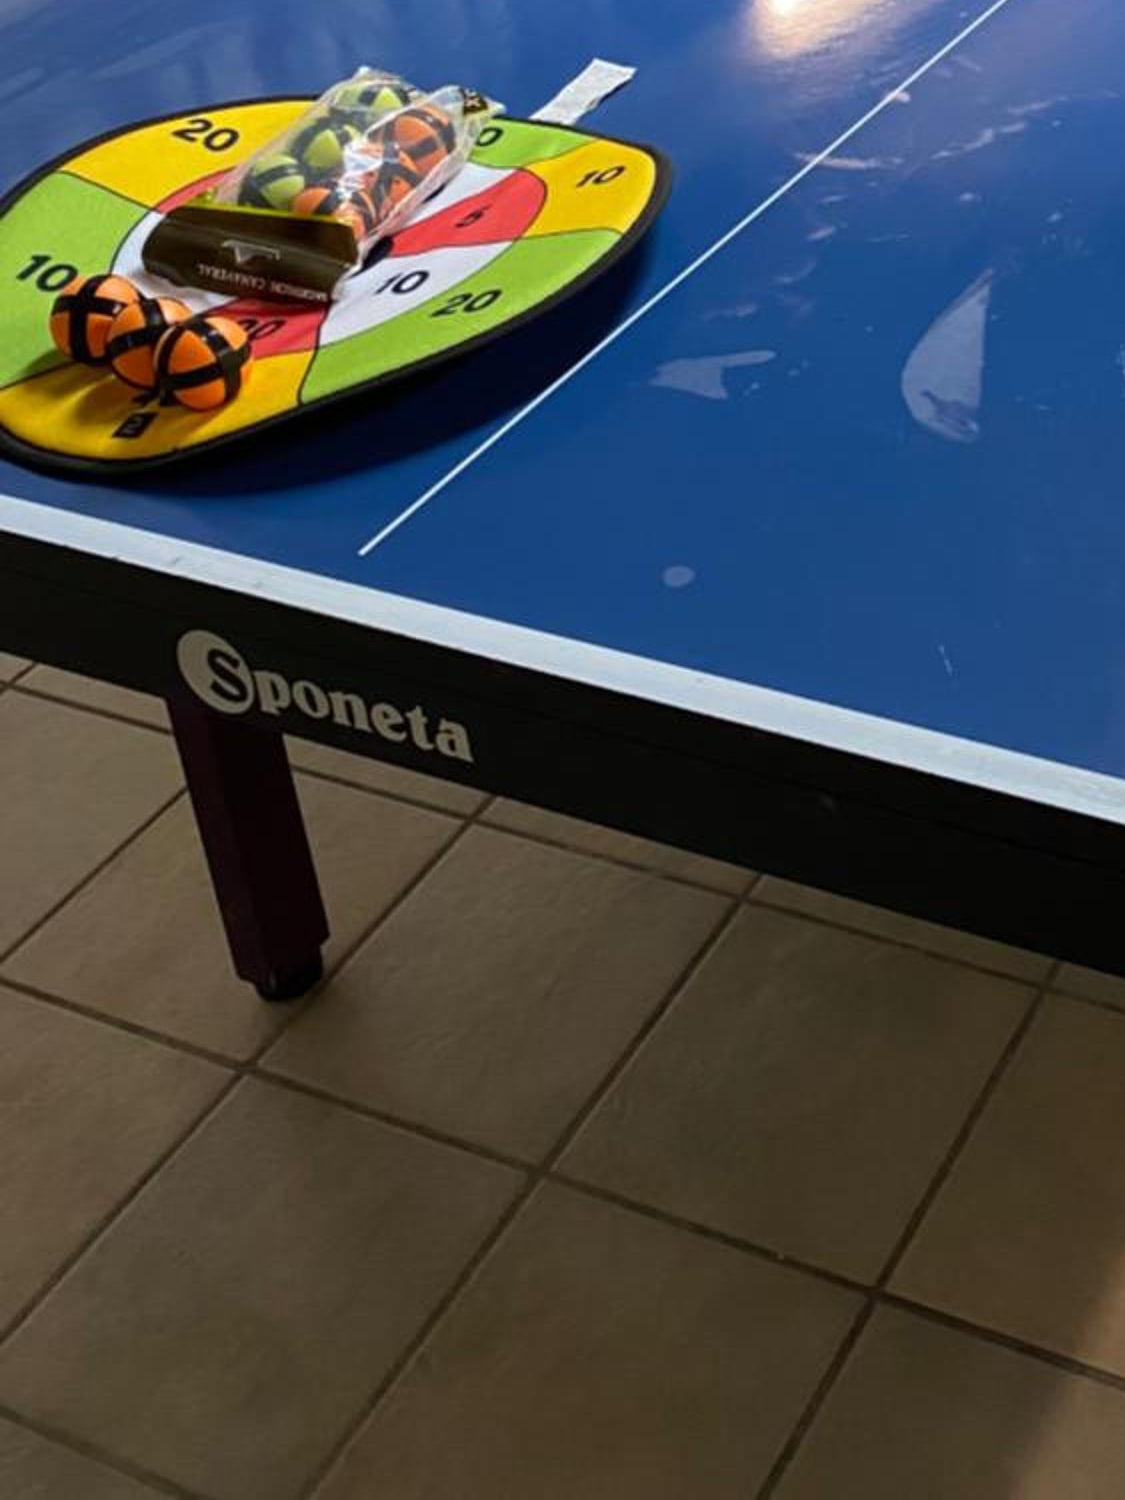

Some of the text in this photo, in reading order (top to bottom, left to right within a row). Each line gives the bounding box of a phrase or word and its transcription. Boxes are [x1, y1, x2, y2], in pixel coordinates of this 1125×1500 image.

[172, 118, 239, 152] 20
[475, 126, 503, 147] 0
[576, 165, 626, 188] 10
[16, 254, 78, 292] 10
[373, 269, 430, 295] 10
[430, 289, 502, 317] 20
[202, 645, 475, 763] Sponeta
